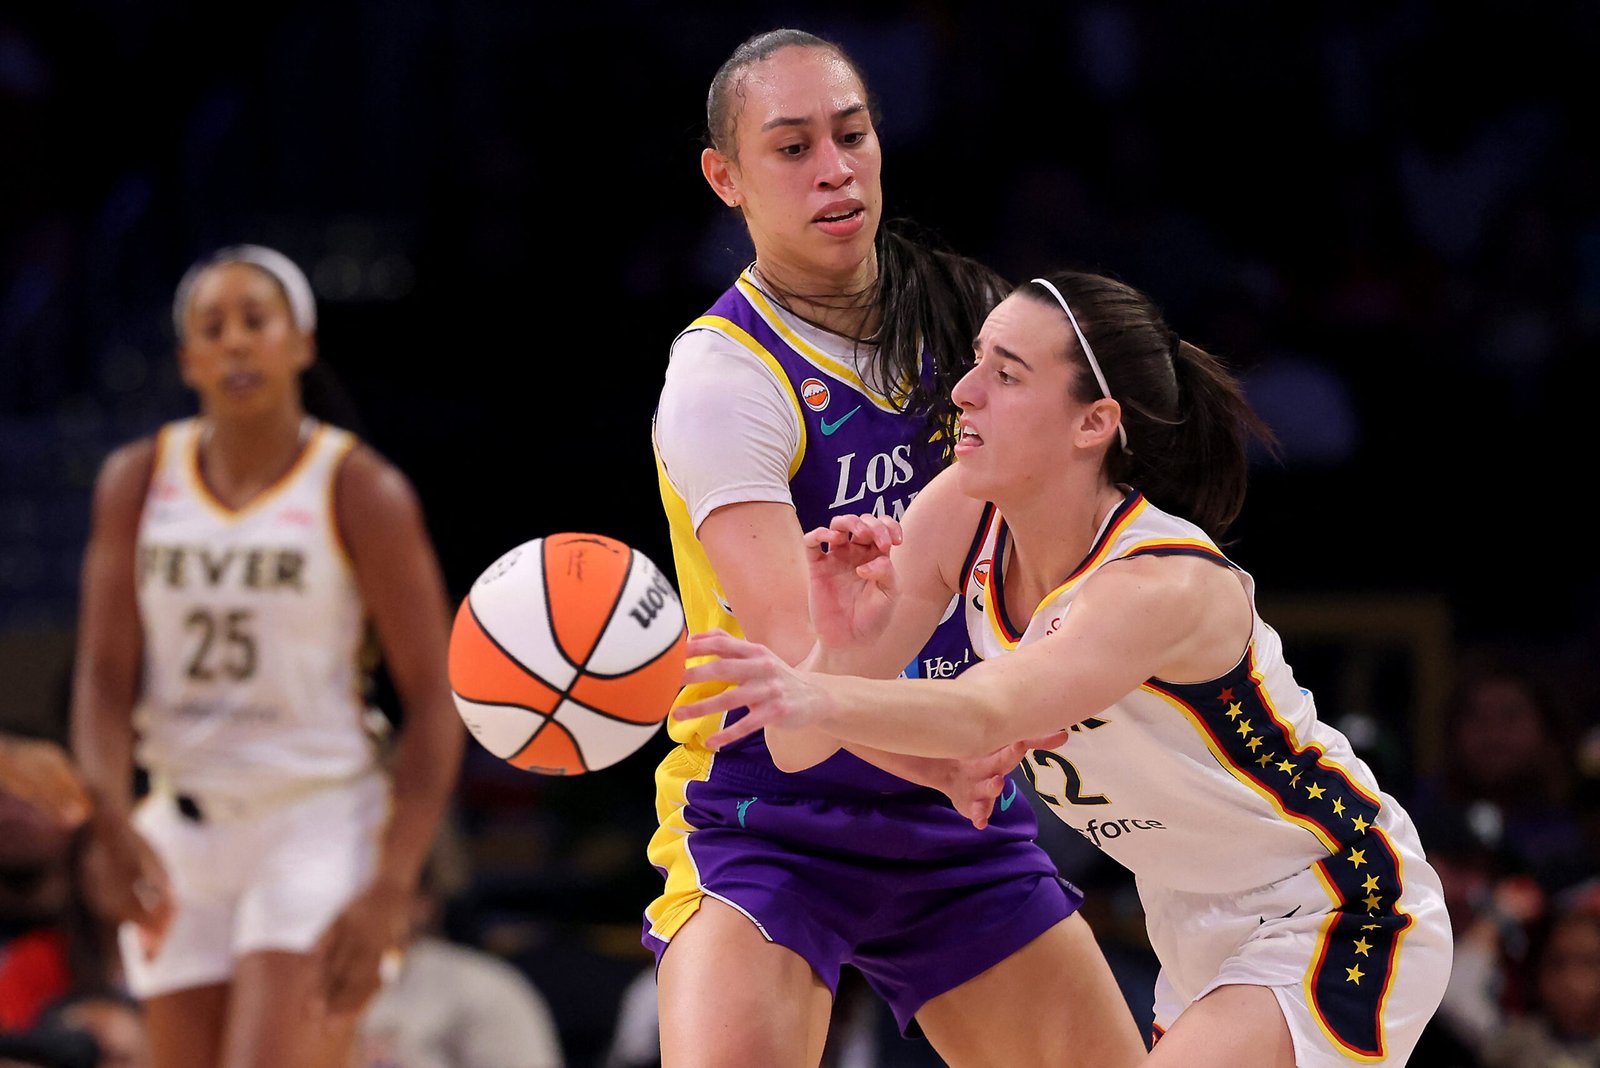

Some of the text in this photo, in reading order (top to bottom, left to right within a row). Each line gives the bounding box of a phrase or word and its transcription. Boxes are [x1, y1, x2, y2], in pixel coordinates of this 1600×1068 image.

[828, 444, 914, 510] LOS
[141, 545, 307, 590] FEVER
[184, 608, 259, 684] 25
